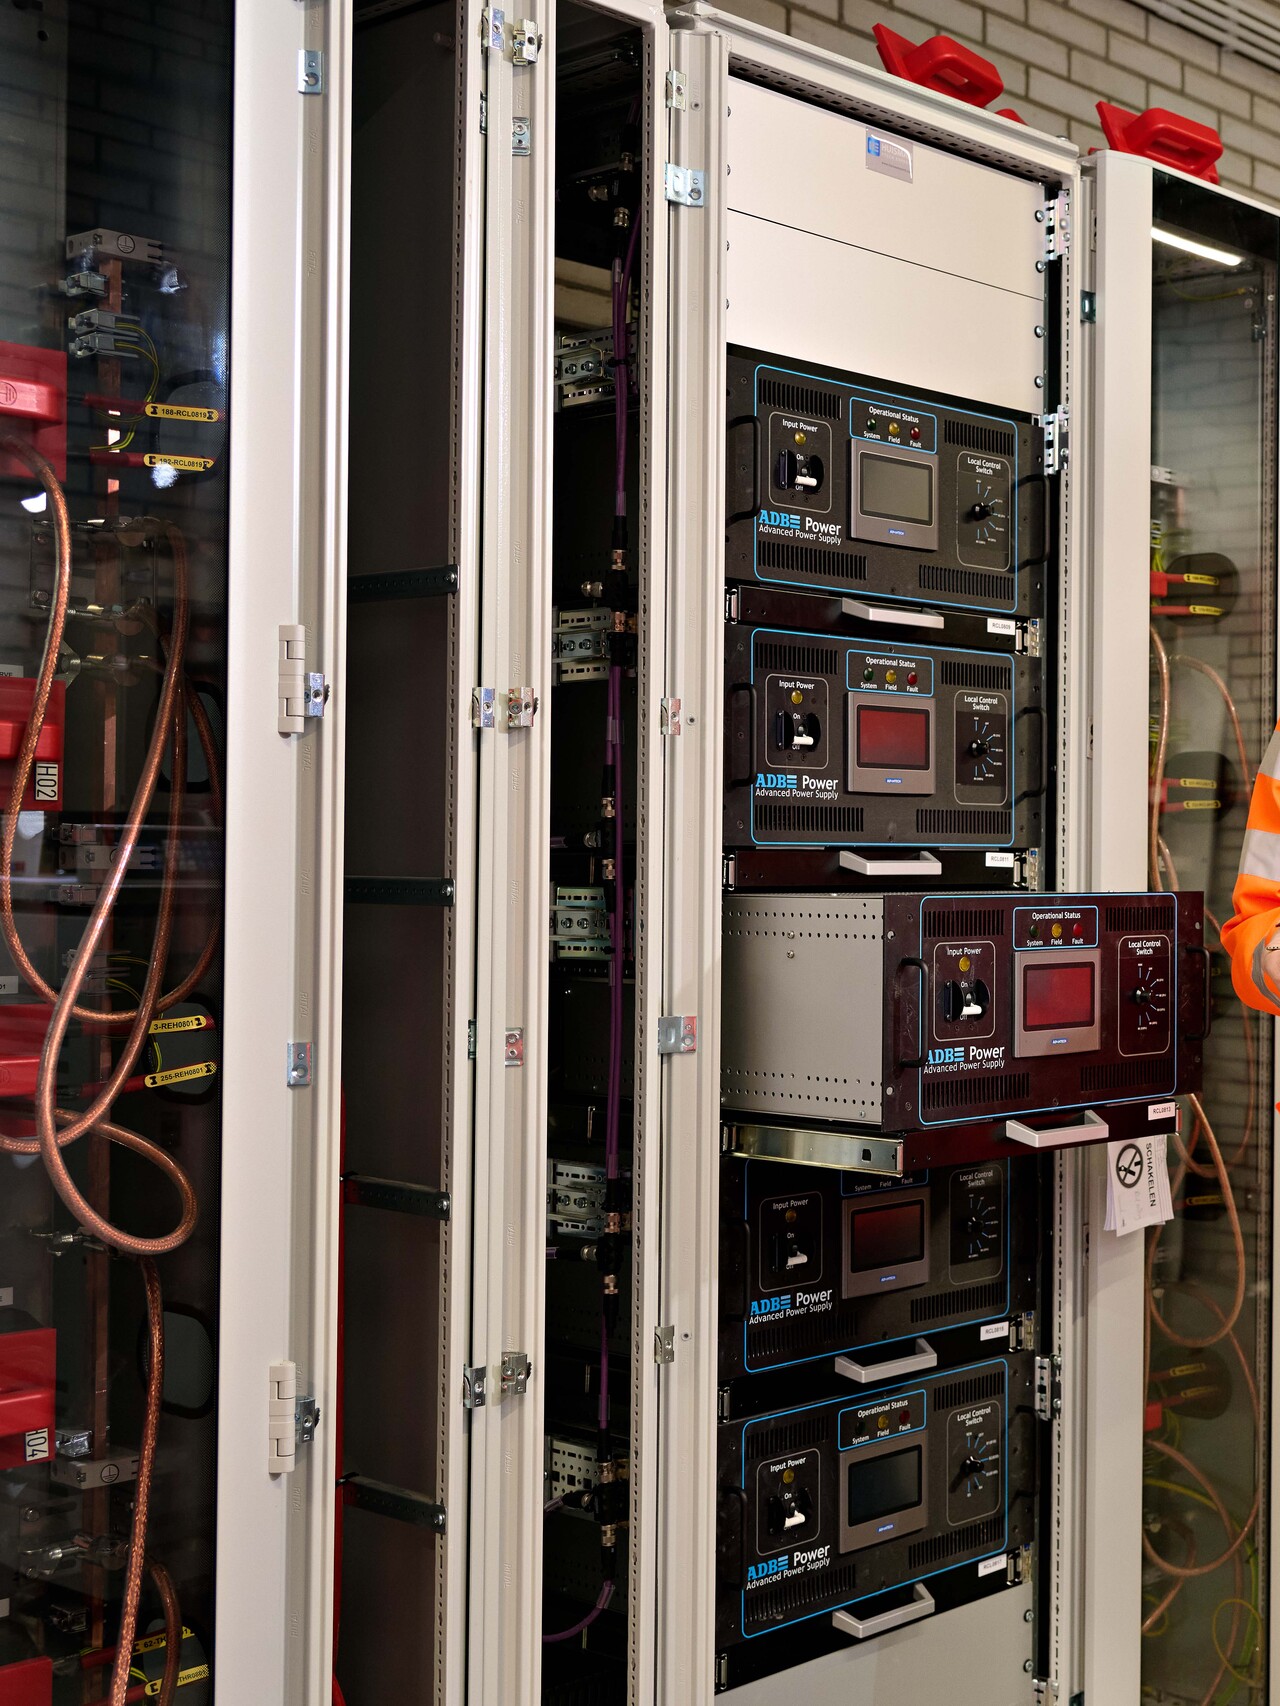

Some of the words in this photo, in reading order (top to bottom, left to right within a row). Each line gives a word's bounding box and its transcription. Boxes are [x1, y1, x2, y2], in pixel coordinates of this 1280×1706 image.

[161, 408, 207, 419] 188-RCL0819
[869, 407, 900, 419] Operational
[902, 413, 919, 424] Status
[782, 419, 797, 429] Input
[799, 422, 818, 433] Power
[864, 431, 881, 440] System
[888, 436, 900, 444] Field
[910, 440, 922, 448] Fault
[968, 458, 981, 467] Local
[982, 460, 1001, 470] Control
[976, 466, 993, 475] Switch
[806, 518, 841, 536] Power
[759, 524, 793, 539] Advanced
[795, 530, 815, 542] Power
[817, 533, 842, 546] Supply
[866, 657, 898, 667] Operational
[899, 660, 916, 668] Status
[779, 681, 795, 690] Input
[796, 682, 814, 691] Power
[860, 682, 877, 690] System
[885, 683, 897, 691] Field
[907, 685, 918, 693] Fault
[965, 696, 978, 704] Local
[973, 703, 990, 711] Switch
[36, 765, 57, 799] H02
[802, 775, 838, 790] Power
[756, 788, 790, 798] Advanced
[792, 790, 813, 798] Power
[816, 790, 838, 800] Supply
[1032, 912, 1063, 921] Operational
[1065, 911, 1081, 919] Status
[1027, 939, 1043, 947] System
[1143, 939, 1161, 947] Control
[947, 948, 963, 956] Input
[964, 947, 982, 955] Power
[970, 1046, 1005, 1060] Power
[924, 1062, 956, 1074] Advanced
[958, 1061, 980, 1071] Power
[982, 1058, 1005, 1070] Supply
[1153, 1107, 1171, 1115] RCL0813
[960, 1172, 973, 1182] Local
[975, 1170, 993, 1178] Control
[1146, 1143, 1156, 1207] SCHAKELEN
[880, 1180, 891, 1188] Field
[902, 1177, 913, 1185] Fault
[968, 1178, 985, 1187] Switch
[855, 1184, 872, 1192] System
[772, 1201, 788, 1210] Input
[790, 1198, 808, 1208] Power
[796, 1289, 832, 1306] Power
[749, 1309, 784, 1325] Advanced
[786, 1305, 807, 1317] Power
[809, 1301, 833, 1313] Supply
[858, 1404, 890, 1418] Operational
[892, 1400, 908, 1409] Status
[957, 1412, 972, 1422] Local
[973, 1407, 991, 1418] Control
[965, 1416, 983, 1426] Switch
[899, 1423, 911, 1432] Fault
[877, 1429, 890, 1438] Field
[26, 1428, 48, 1458] H04
[852, 1434, 869, 1445] System
[770, 1461, 787, 1473] Input
[788, 1457, 806, 1469] Power
[794, 1544, 830, 1565] Power
[746, 1572, 781, 1591] Advanced
[783, 1565, 805, 1581] Power
[806, 1557, 830, 1573] Supply
